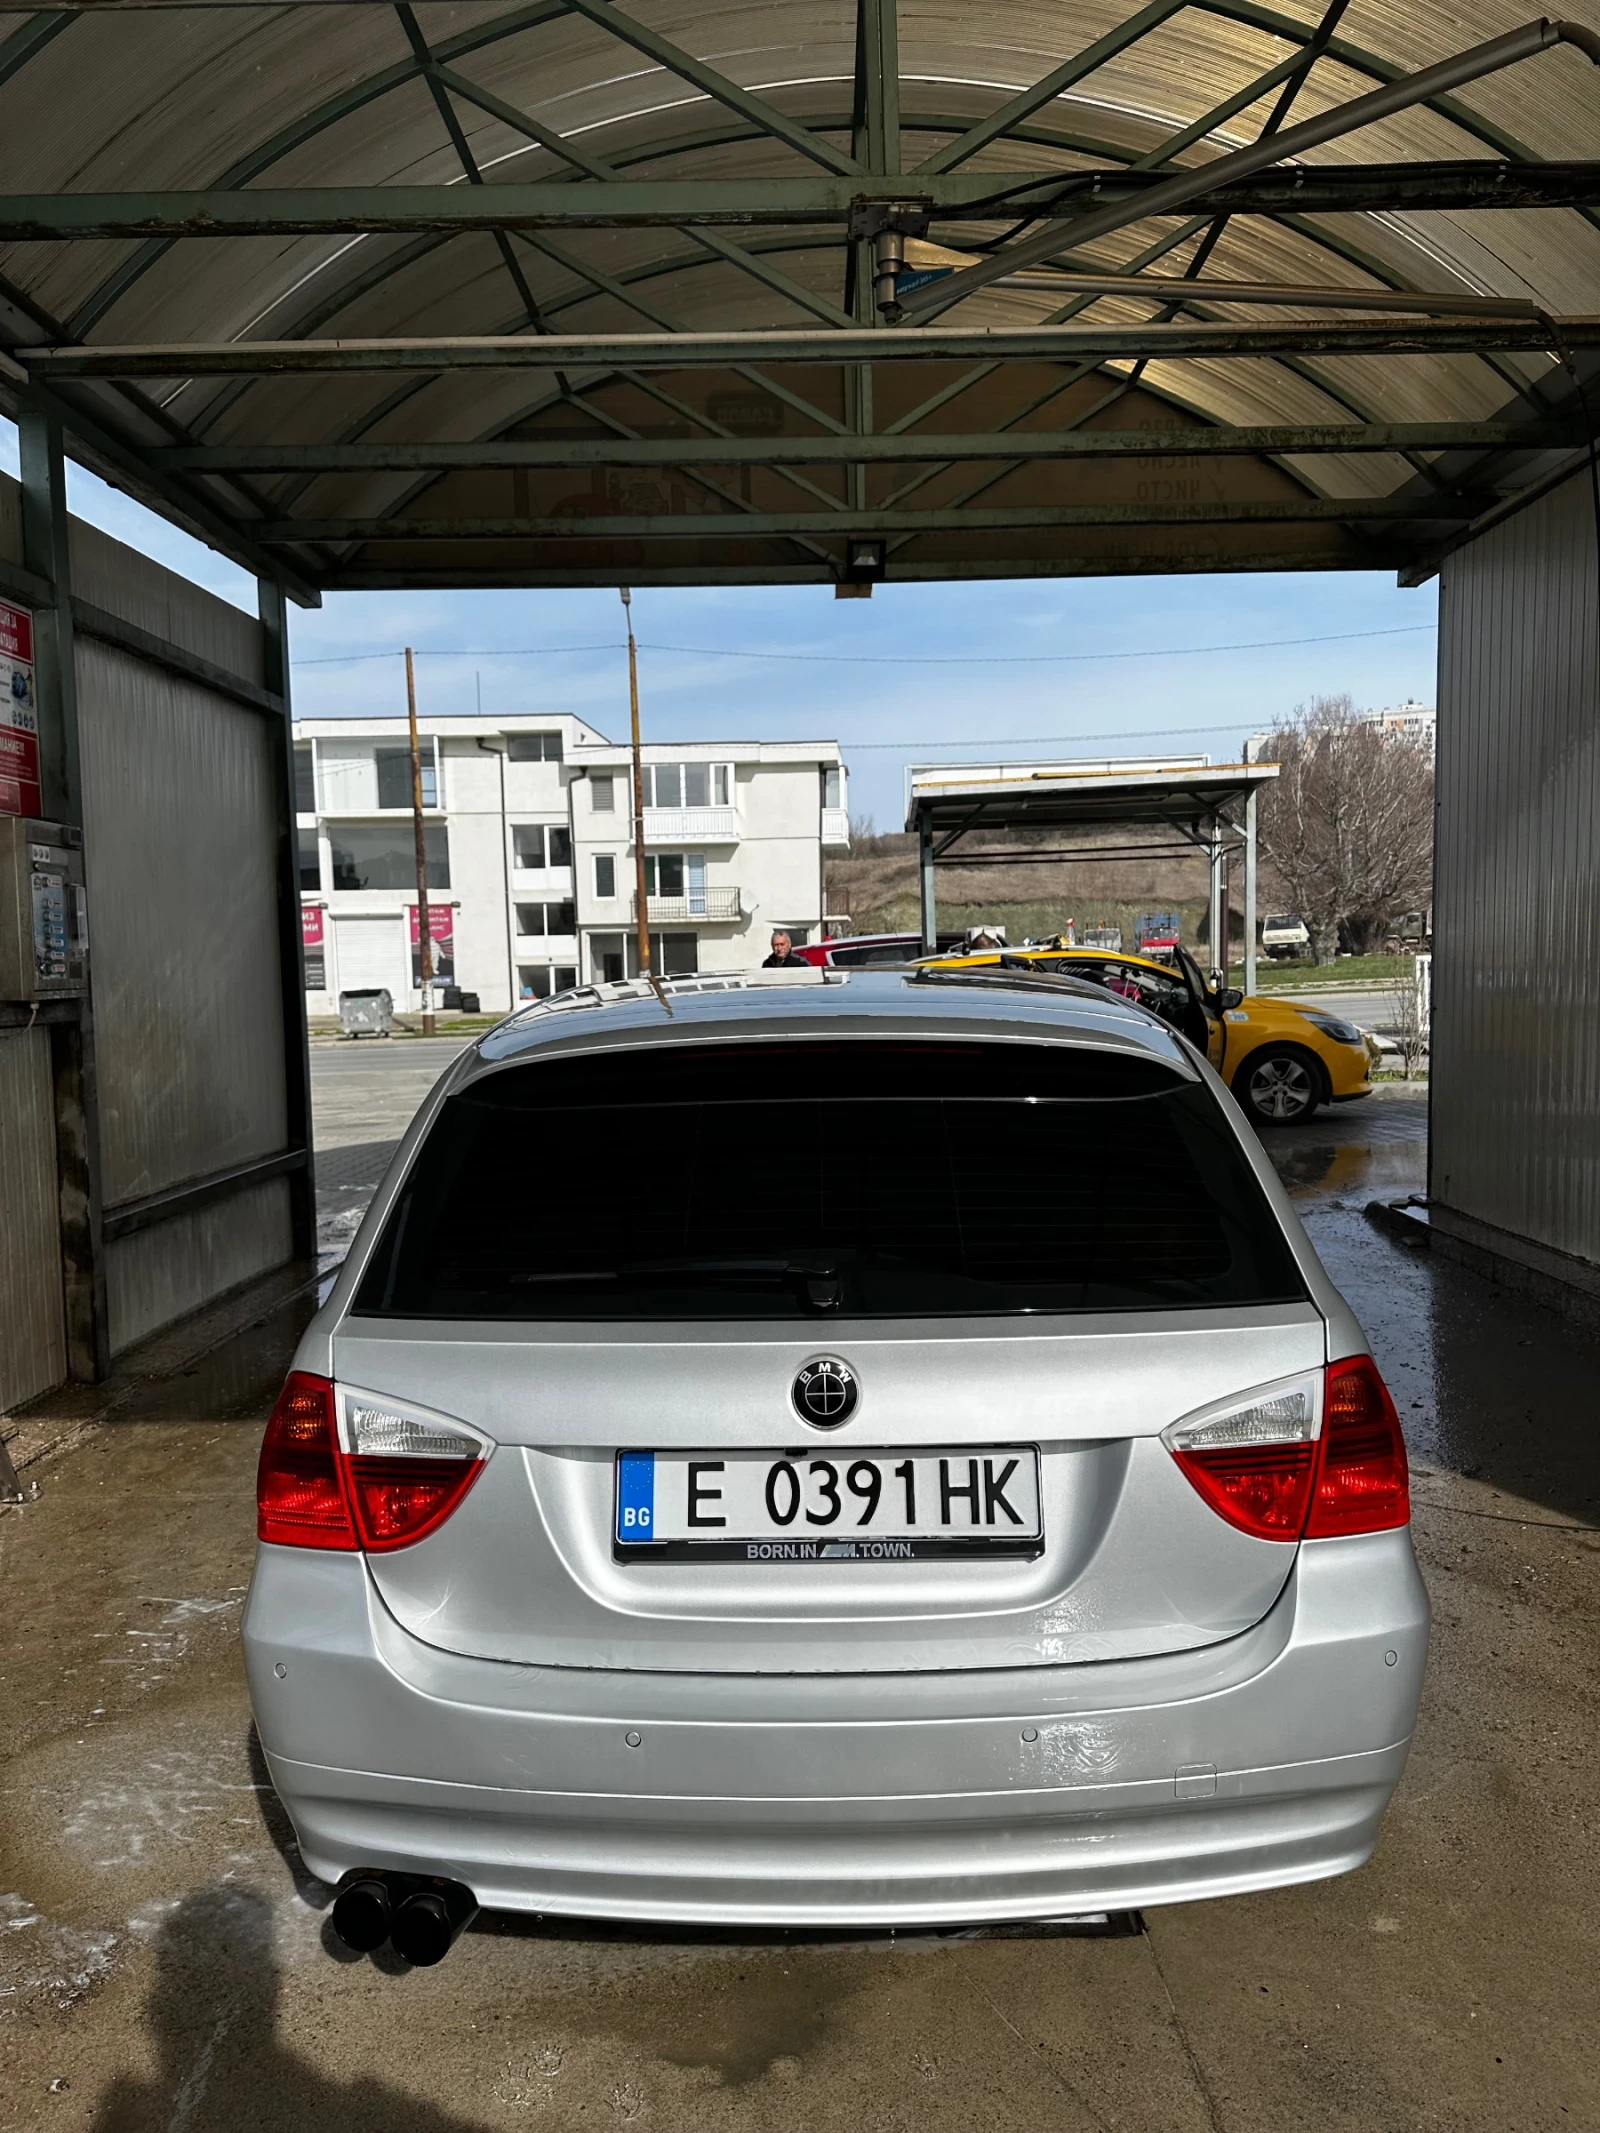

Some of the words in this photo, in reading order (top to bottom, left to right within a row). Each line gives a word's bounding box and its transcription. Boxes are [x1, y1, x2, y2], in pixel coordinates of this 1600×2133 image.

[799, 1361, 852, 1384] BMW
[687, 1461, 727, 1527] E
[765, 1459, 916, 1526] 0391
[940, 1458, 1025, 1526] HK
[624, 1507, 651, 1527] BG
